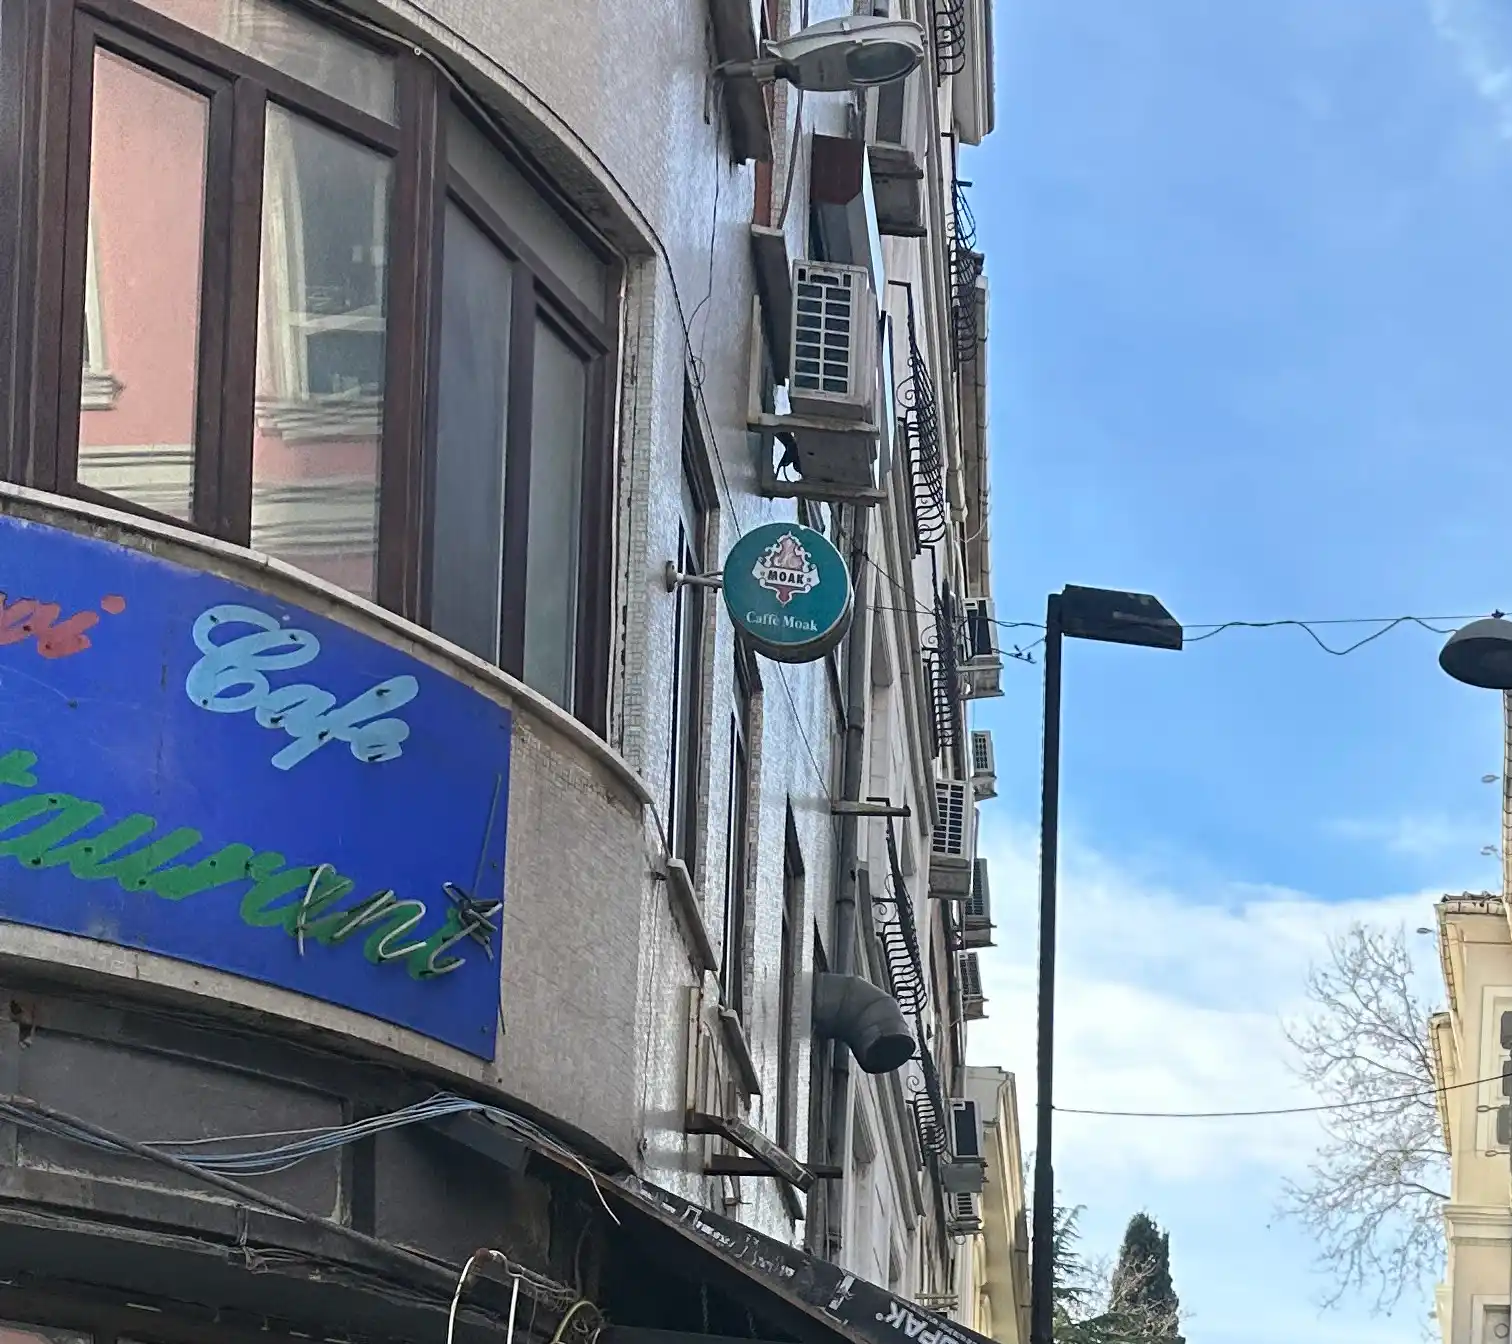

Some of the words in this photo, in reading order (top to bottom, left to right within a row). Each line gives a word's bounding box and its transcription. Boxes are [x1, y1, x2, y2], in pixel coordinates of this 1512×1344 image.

[767, 569, 805, 584] MOAK
[783, 616, 818, 632] Moak
[186, 604, 419, 770] Cafe
[0, 750, 502, 981] aurant
